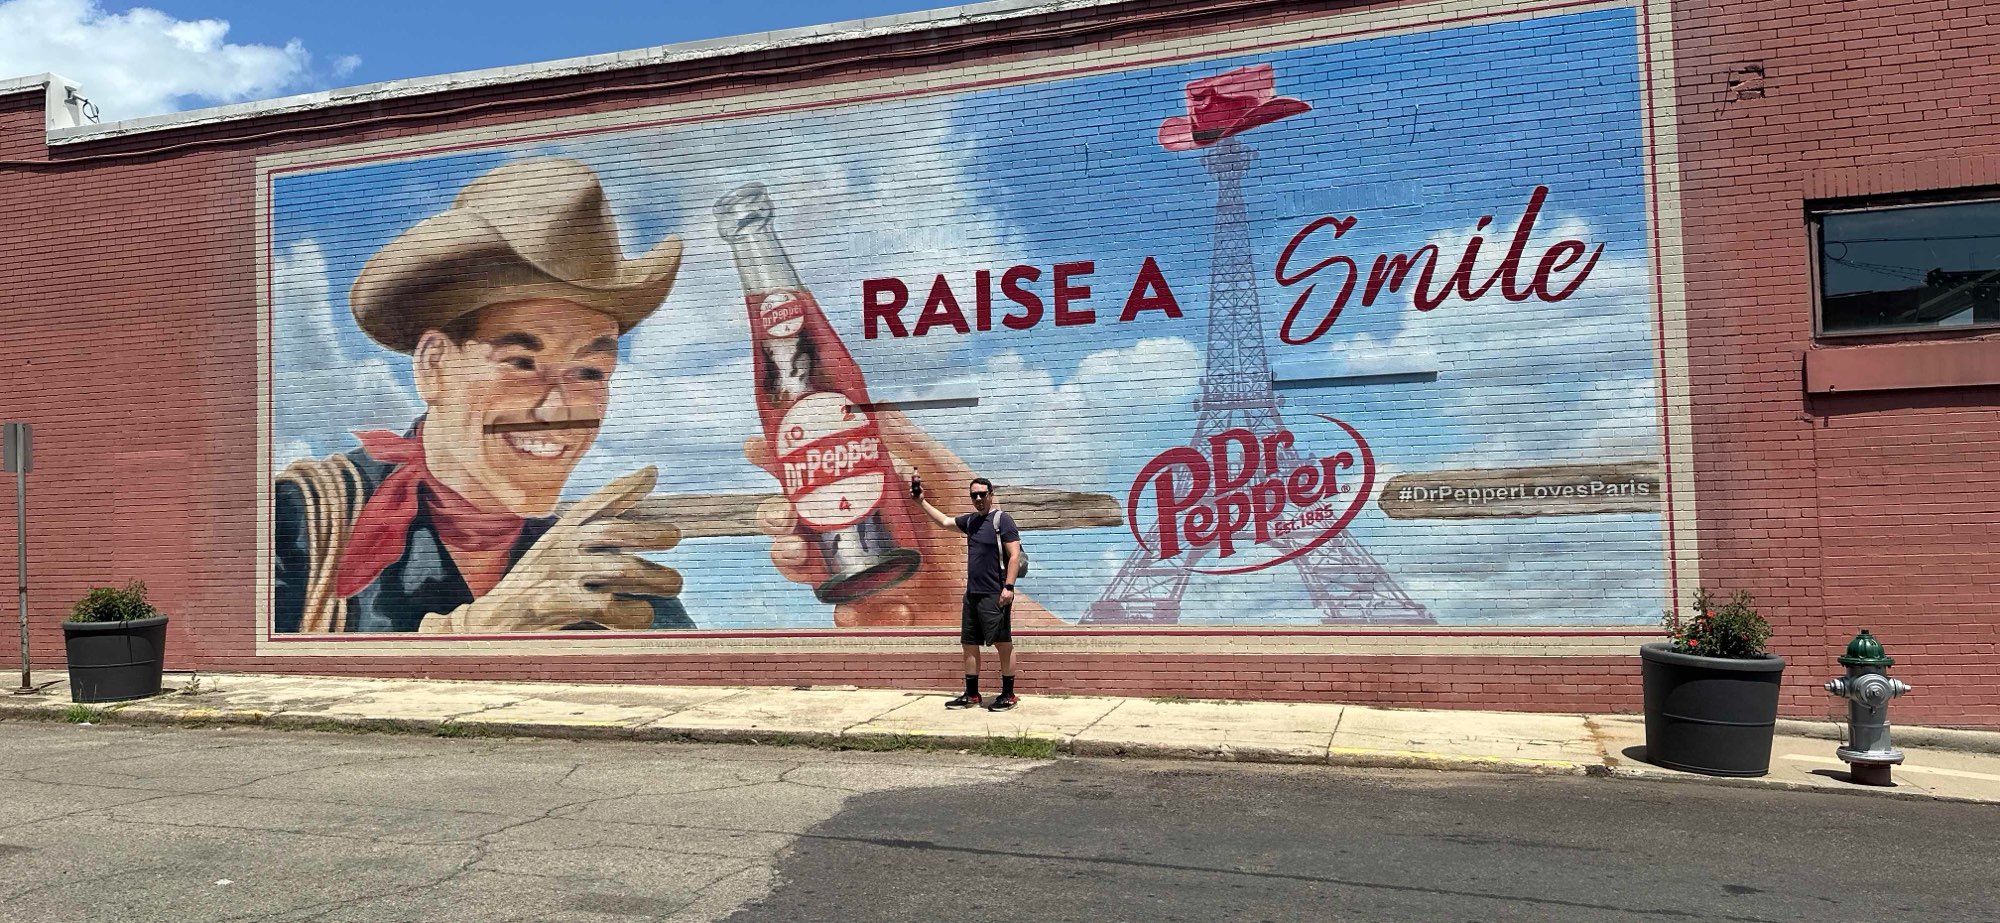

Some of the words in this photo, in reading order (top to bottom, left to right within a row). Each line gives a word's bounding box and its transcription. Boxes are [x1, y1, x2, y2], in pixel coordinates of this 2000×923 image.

[862, 261, 1096, 340] RAISE
[1119, 256, 1183, 322] A
[1275, 186, 1604, 346] Smile
[1208, 428, 1295, 497] Dr
[1398, 479, 1651, 504] #DrPepperLovesParis
[1127, 451, 1354, 560] Pepper
